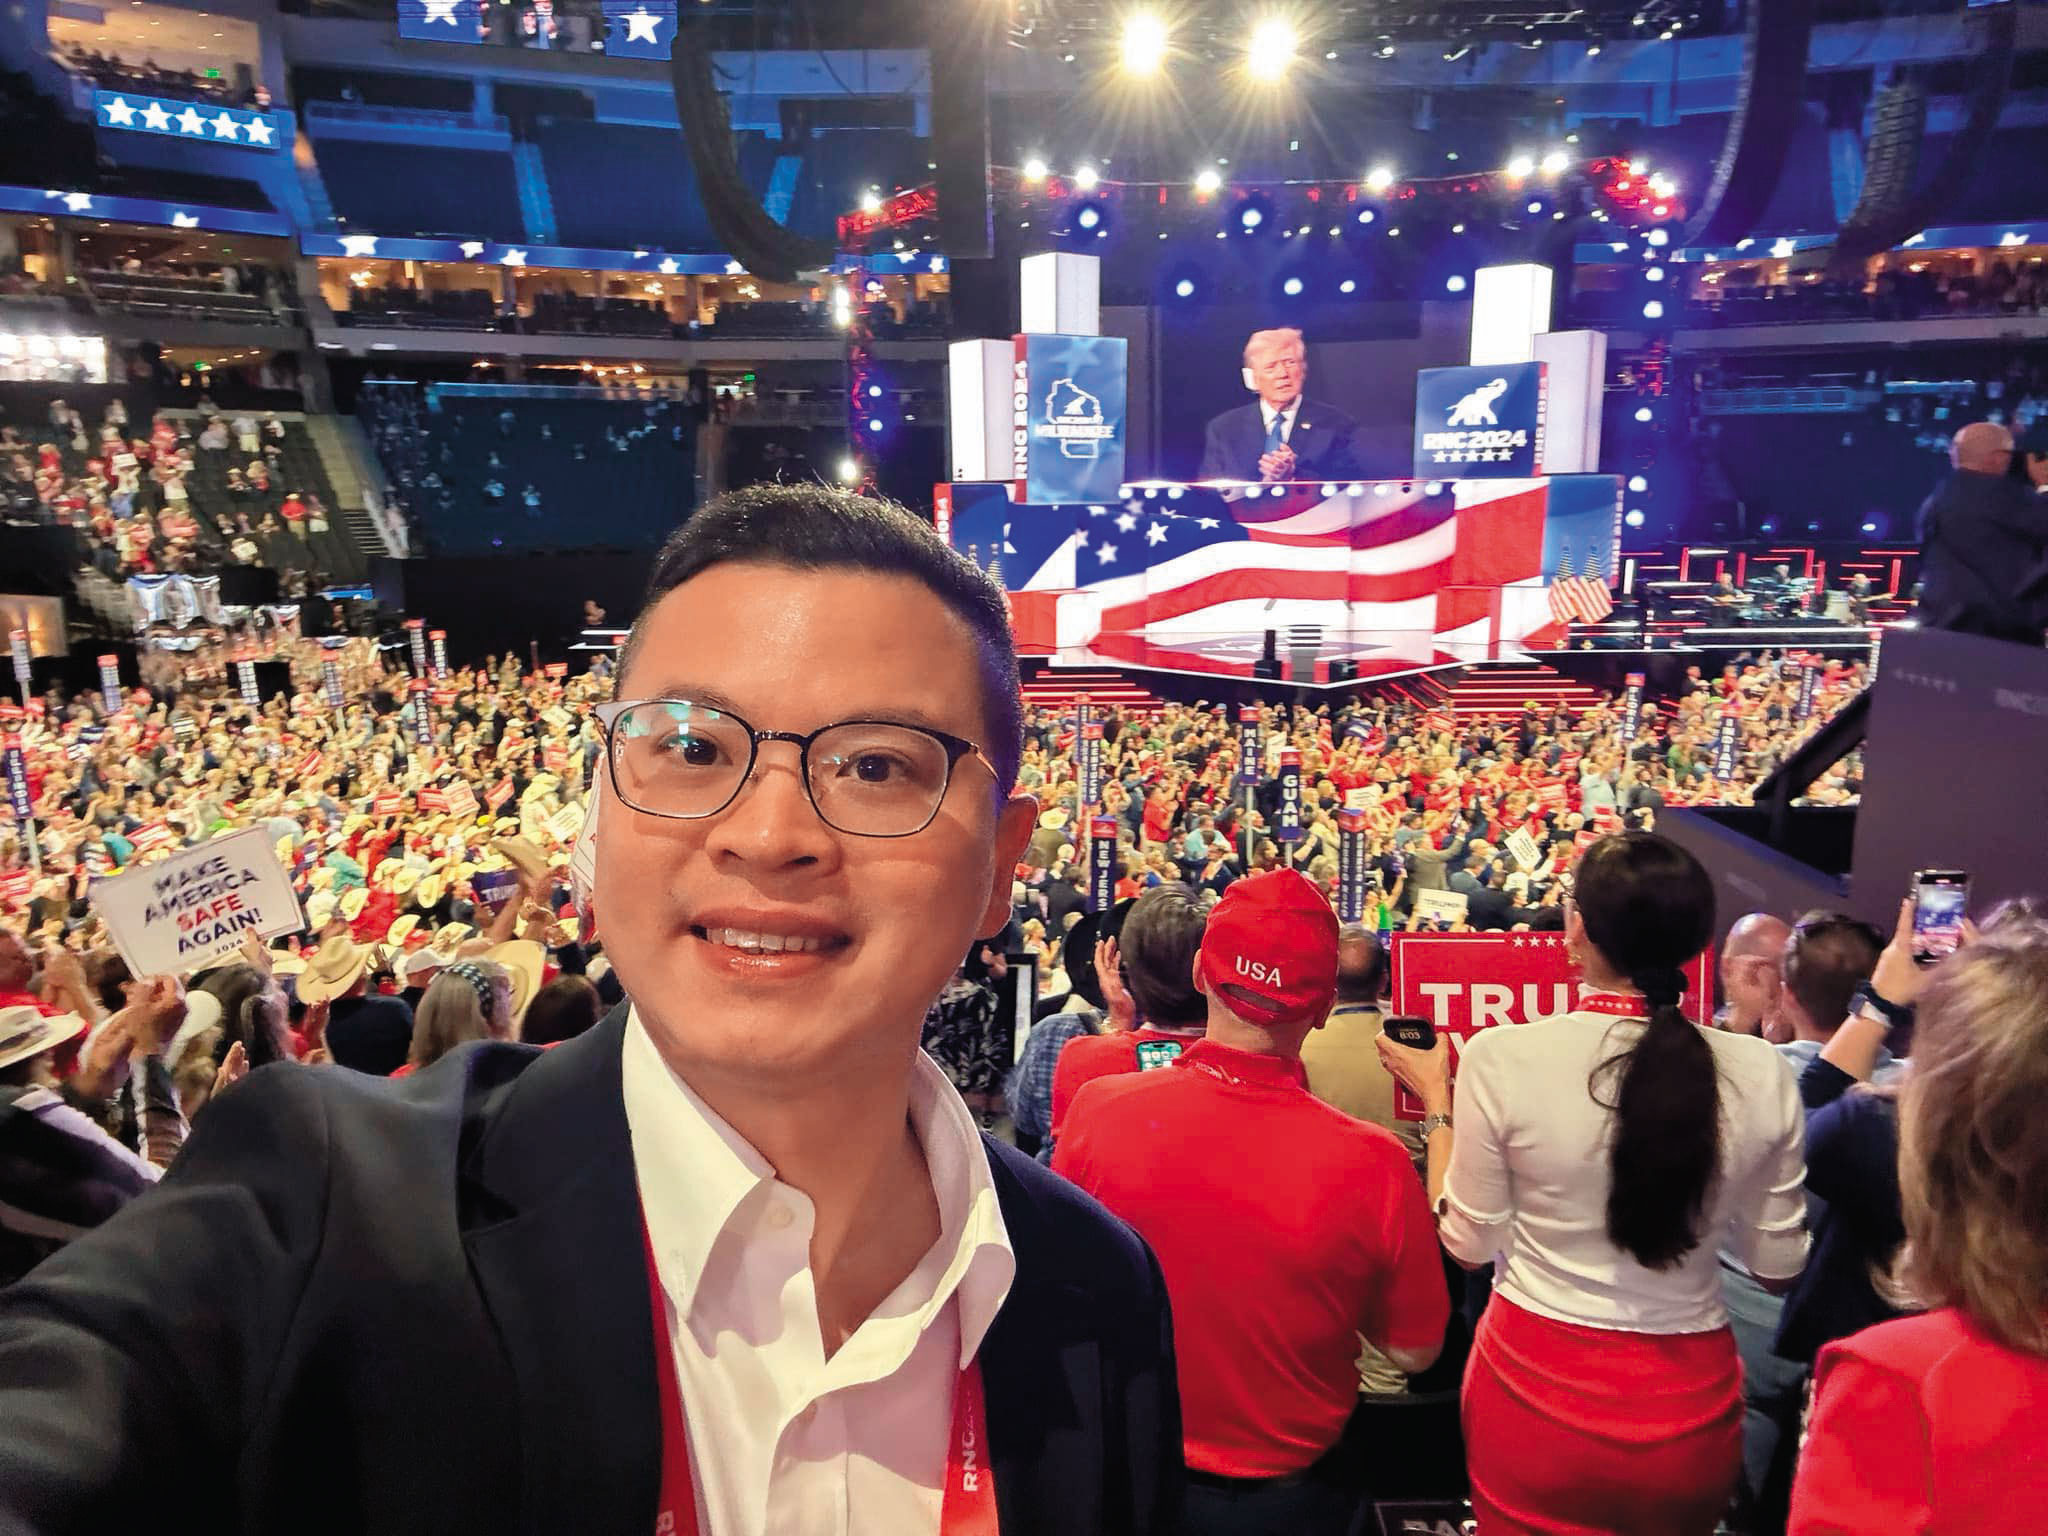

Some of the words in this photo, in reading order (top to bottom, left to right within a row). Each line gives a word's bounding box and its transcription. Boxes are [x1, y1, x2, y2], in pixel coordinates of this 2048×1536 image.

[1243, 728, 1256, 775] MAINE
[1716, 718, 1734, 779] INDIANA
[1283, 774, 1298, 827] GUAM
[154, 856, 229, 893] MAKE
[1097, 840, 1111, 868] NEW
[144, 868, 260, 927] AMERICA
[176, 893, 244, 932] SAFE
[178, 907, 263, 955] AGAIN!
[1235, 955, 1282, 987] USA
